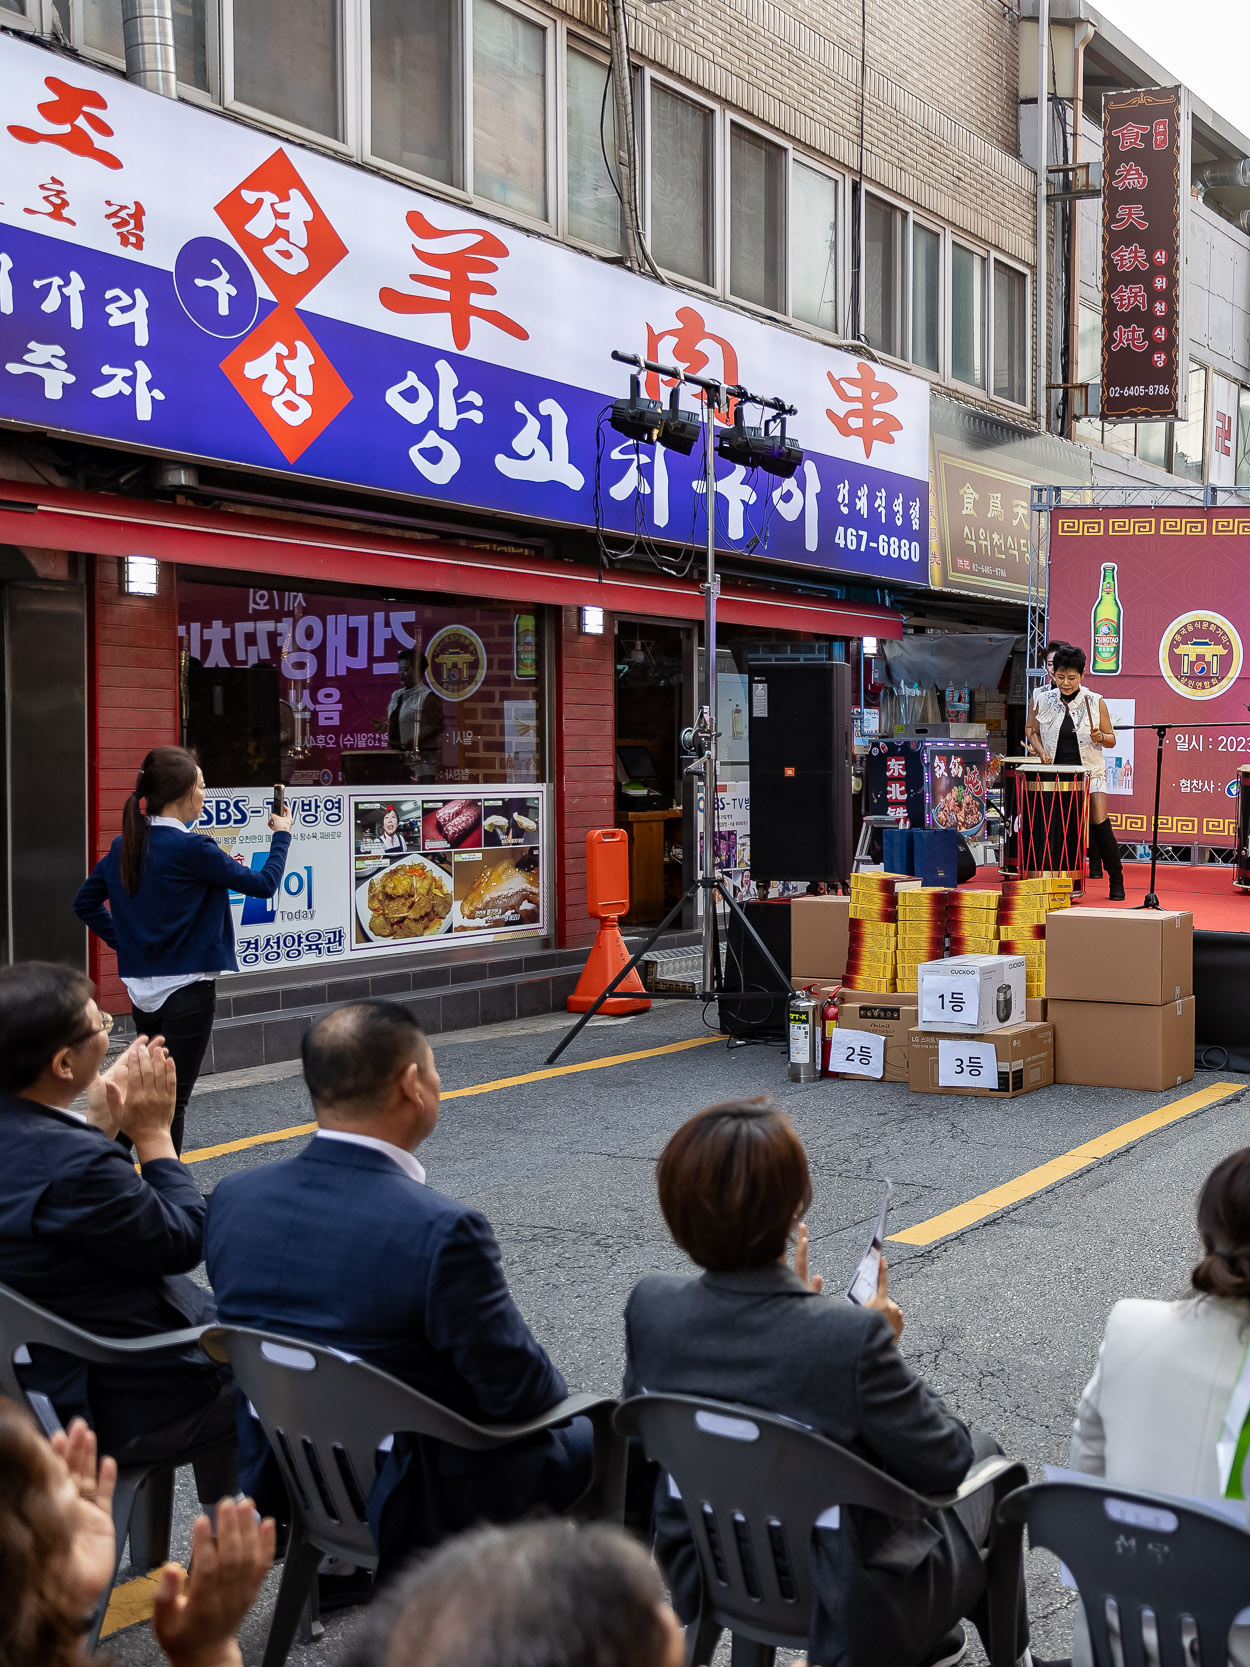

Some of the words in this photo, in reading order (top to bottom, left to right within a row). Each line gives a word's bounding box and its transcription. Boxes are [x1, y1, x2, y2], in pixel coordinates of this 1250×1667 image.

[8, 76, 123, 170] 조
[1152, 249, 1168, 367] 식위천식당
[1109, 385, 1170, 398] 02-6405-8786
[837, 479, 920, 530] 건대직영점
[835, 526, 920, 562] 467-6880
[1175, 734, 1203, 751] 일시
[1179, 779, 1215, 793] 협찬사
[279, 908, 316, 922] Today
[237, 928, 345, 965] 경성양육관
[938, 992, 966, 1012] 1등
[845, 1046, 873, 1066] 2등
[955, 1057, 984, 1077] 3등
